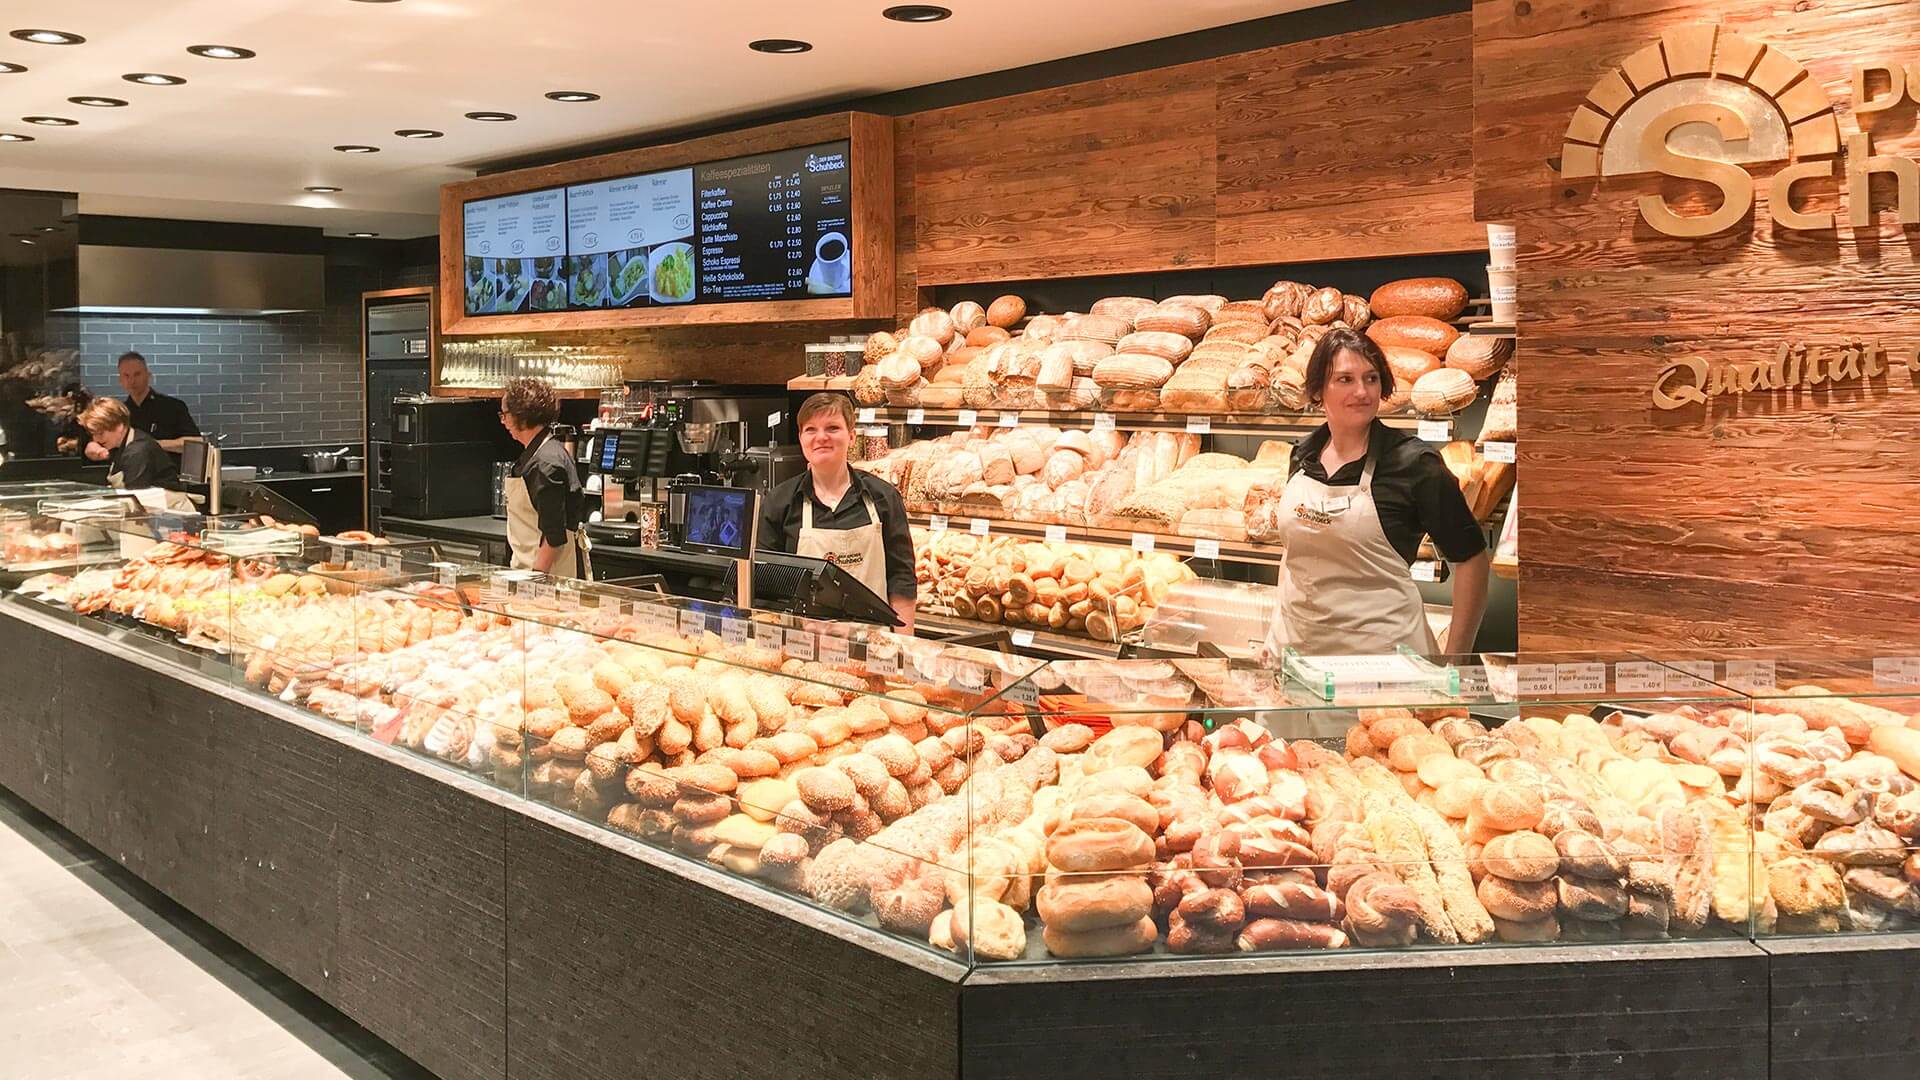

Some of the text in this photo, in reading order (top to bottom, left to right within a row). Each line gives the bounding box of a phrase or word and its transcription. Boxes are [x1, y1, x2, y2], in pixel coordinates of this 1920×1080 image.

[809, 160, 845, 172] Schuhbeck
[1637, 101, 1919, 238] Sch
[701, 201, 716, 210] Kaffee
[701, 211, 729, 222] Cappuccino
[702, 246, 724, 256] Espresso
[702, 258, 719, 267] Schoko
[717, 271, 745, 281] Schokolade
[702, 285, 722, 294] Bio-Tee
[1652, 335, 1885, 410] Qualität
